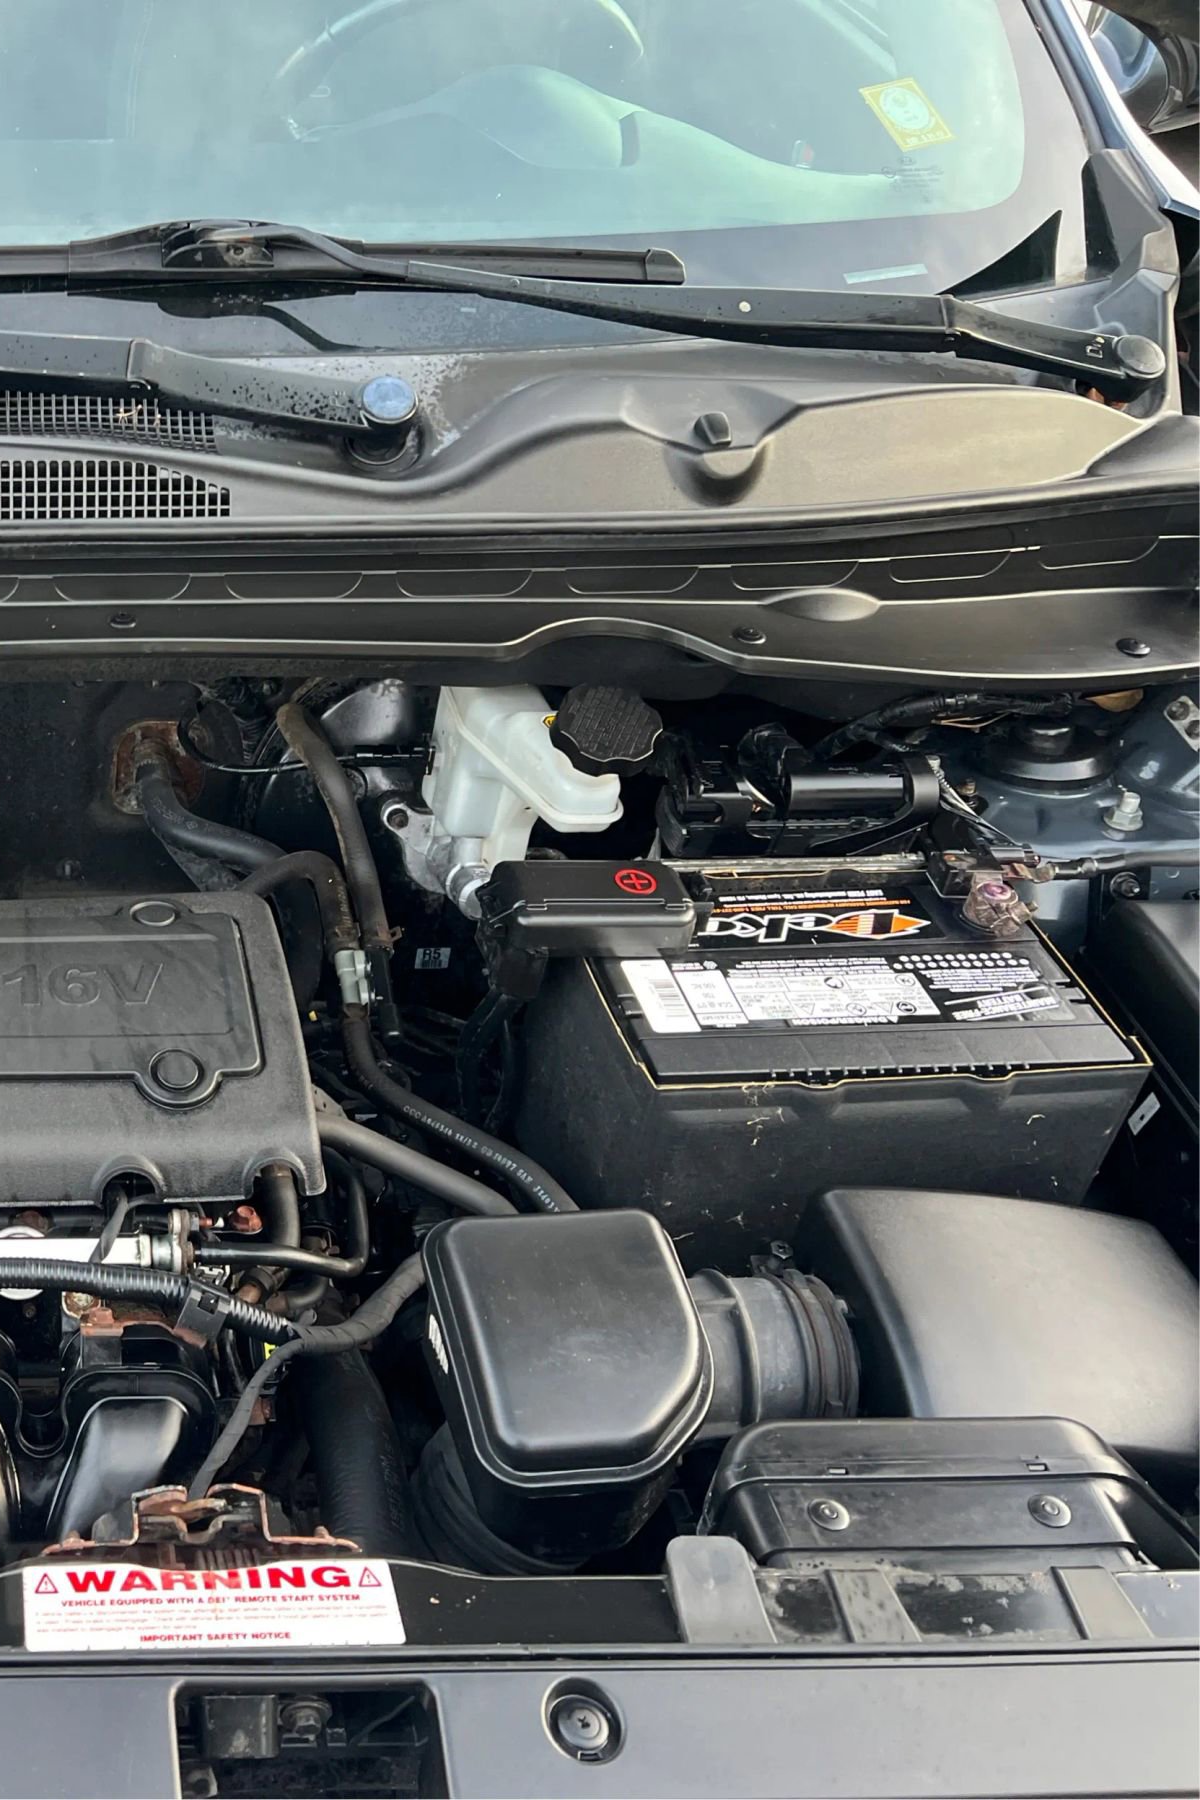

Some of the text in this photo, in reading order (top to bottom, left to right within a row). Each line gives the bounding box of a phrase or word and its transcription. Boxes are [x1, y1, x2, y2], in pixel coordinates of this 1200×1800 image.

[1, 962, 164, 1007] 16V
[66, 1566, 351, 1592] WARNING
[61, 1599, 106, 1607] VEHICLE
[235, 1595, 277, 1603] REMOTE
[140, 1631, 291, 1642] IMPORTANT SAFETY NOTICE
